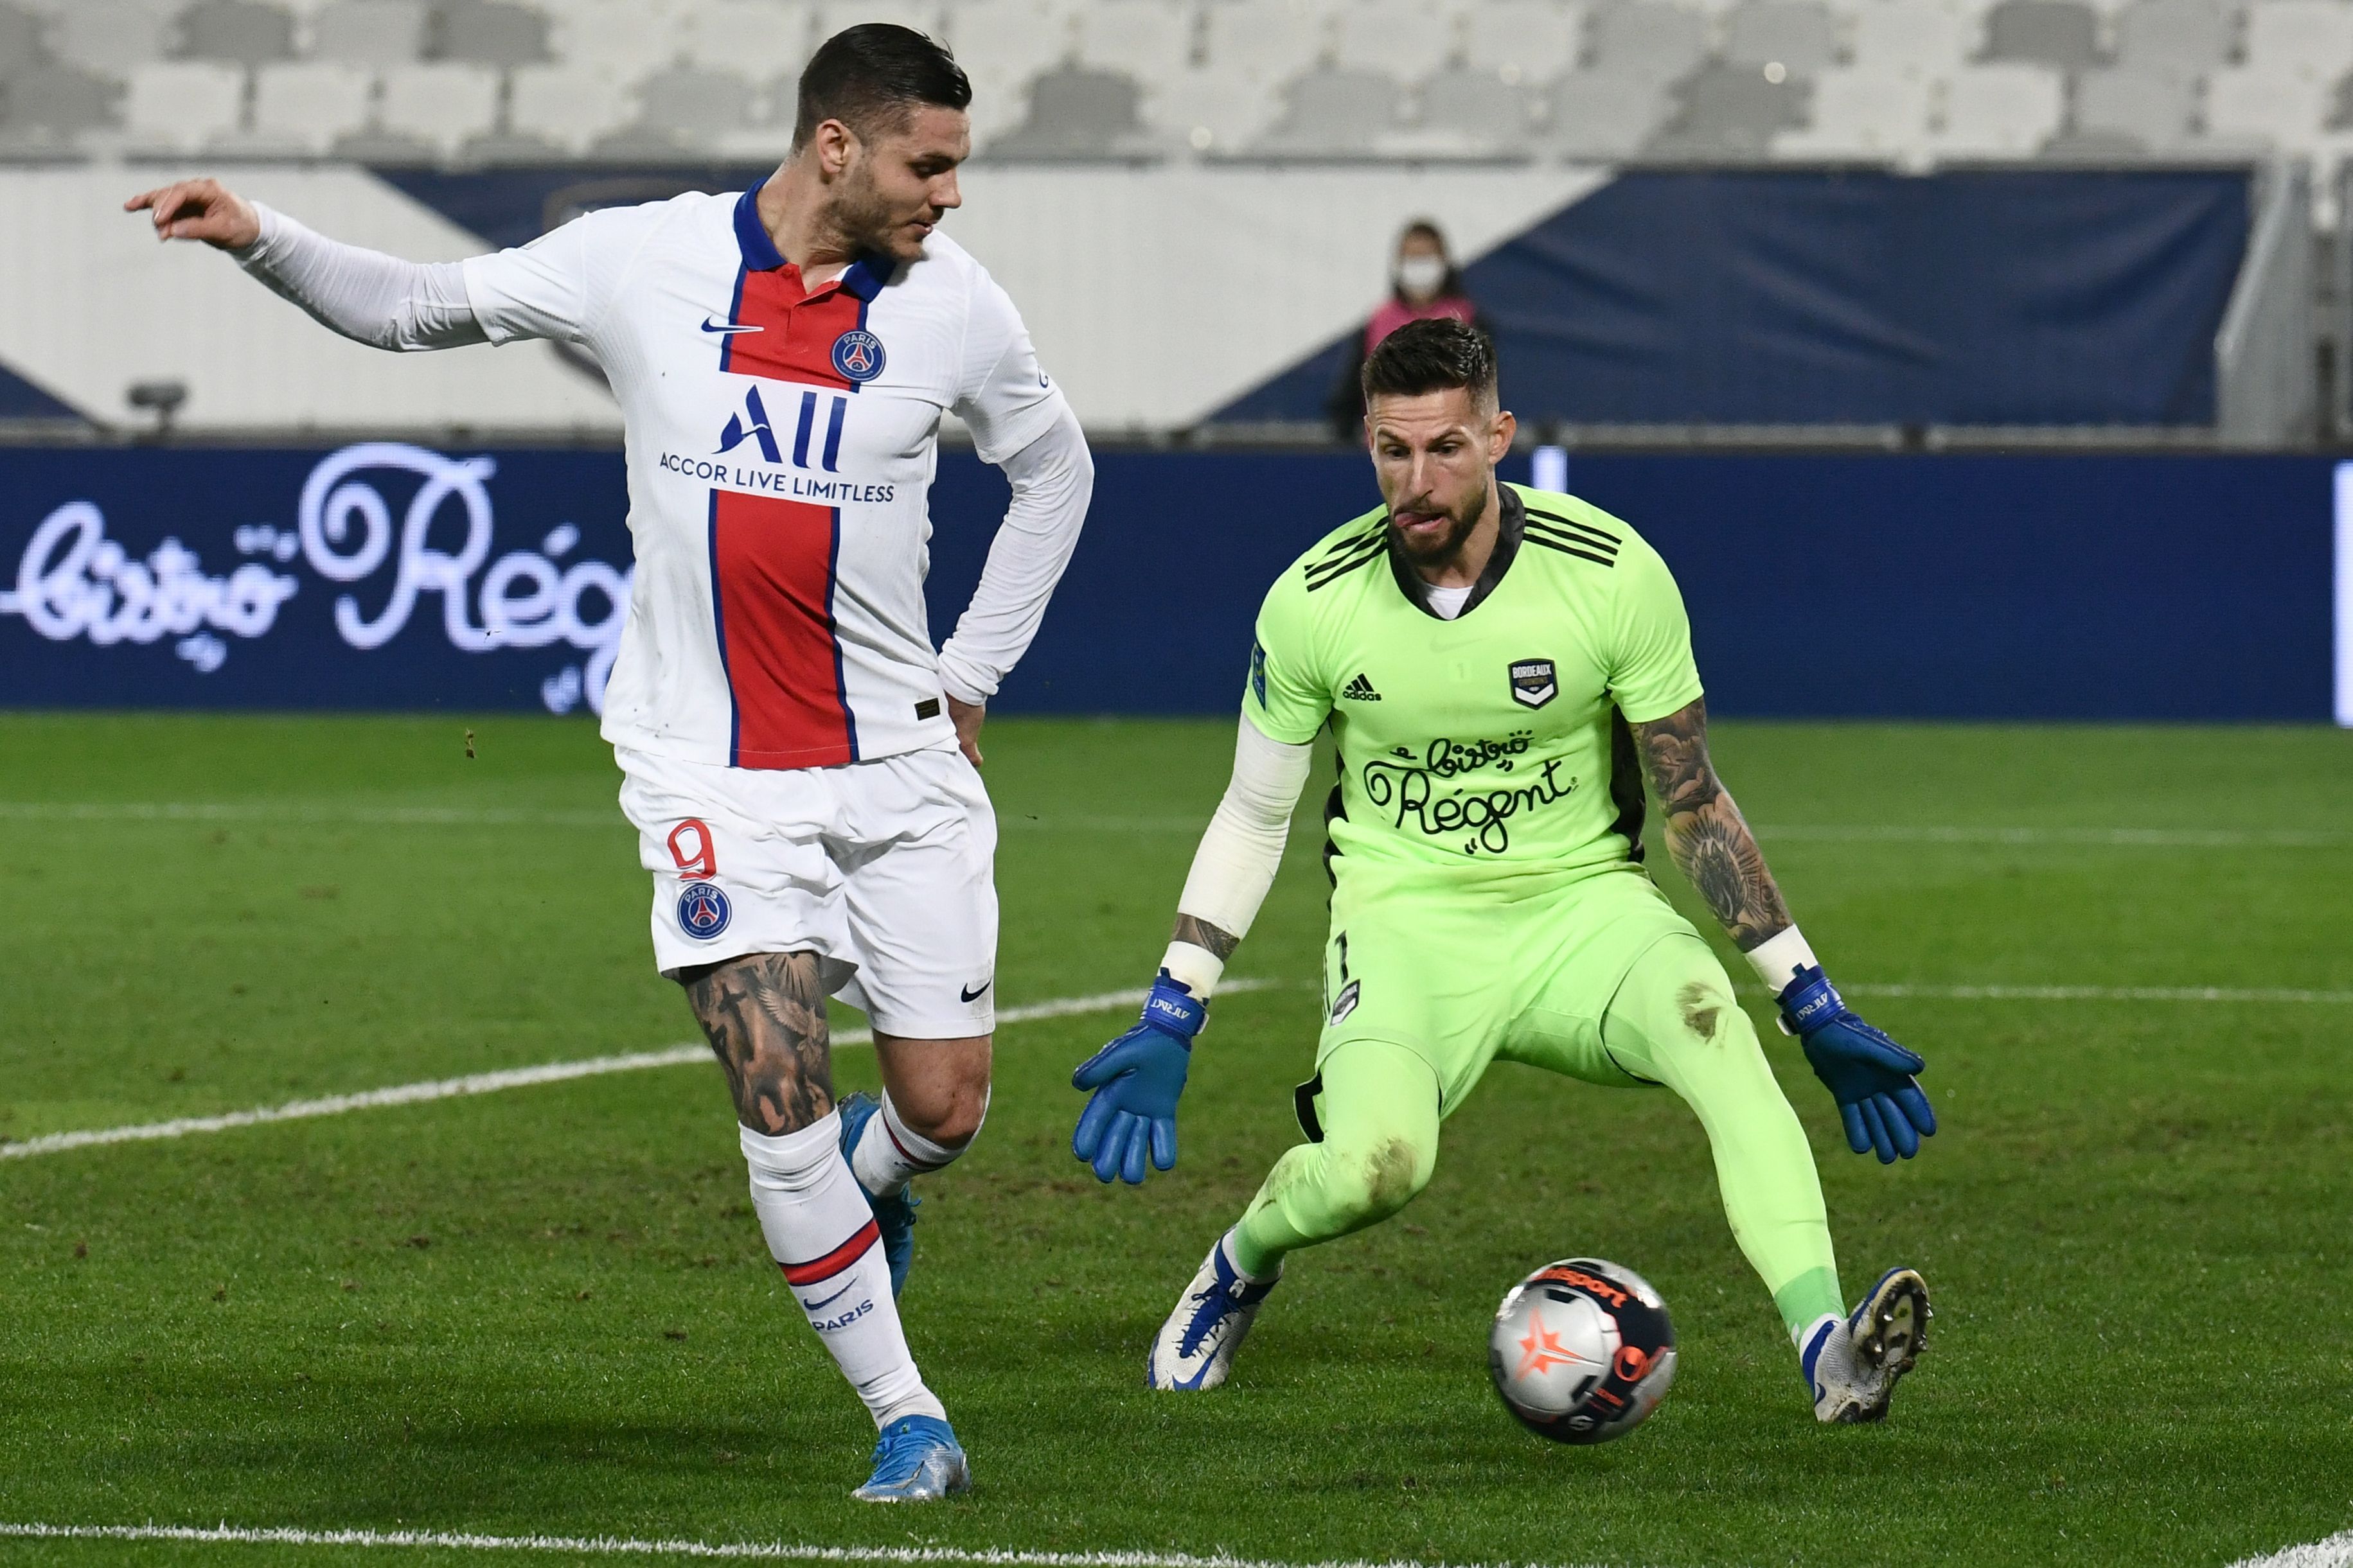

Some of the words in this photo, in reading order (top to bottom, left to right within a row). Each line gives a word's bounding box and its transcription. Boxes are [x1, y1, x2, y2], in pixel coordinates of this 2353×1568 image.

[843, 333, 876, 349] PARIS
[659, 452, 727, 483] ACCOR
[735, 468, 786, 491] LIVE
[794, 477, 894, 503] LIMITLESS
[299, 441, 635, 714] Rég
[1512, 664, 1552, 679] BORDEAUX
[1343, 689, 1382, 701] adidas
[1363, 760, 1572, 854] Régent
[667, 819, 716, 881] 9
[684, 888, 718, 903] PARIS
[1334, 929, 1349, 985] 1
[812, 1299, 873, 1331] PARIS
